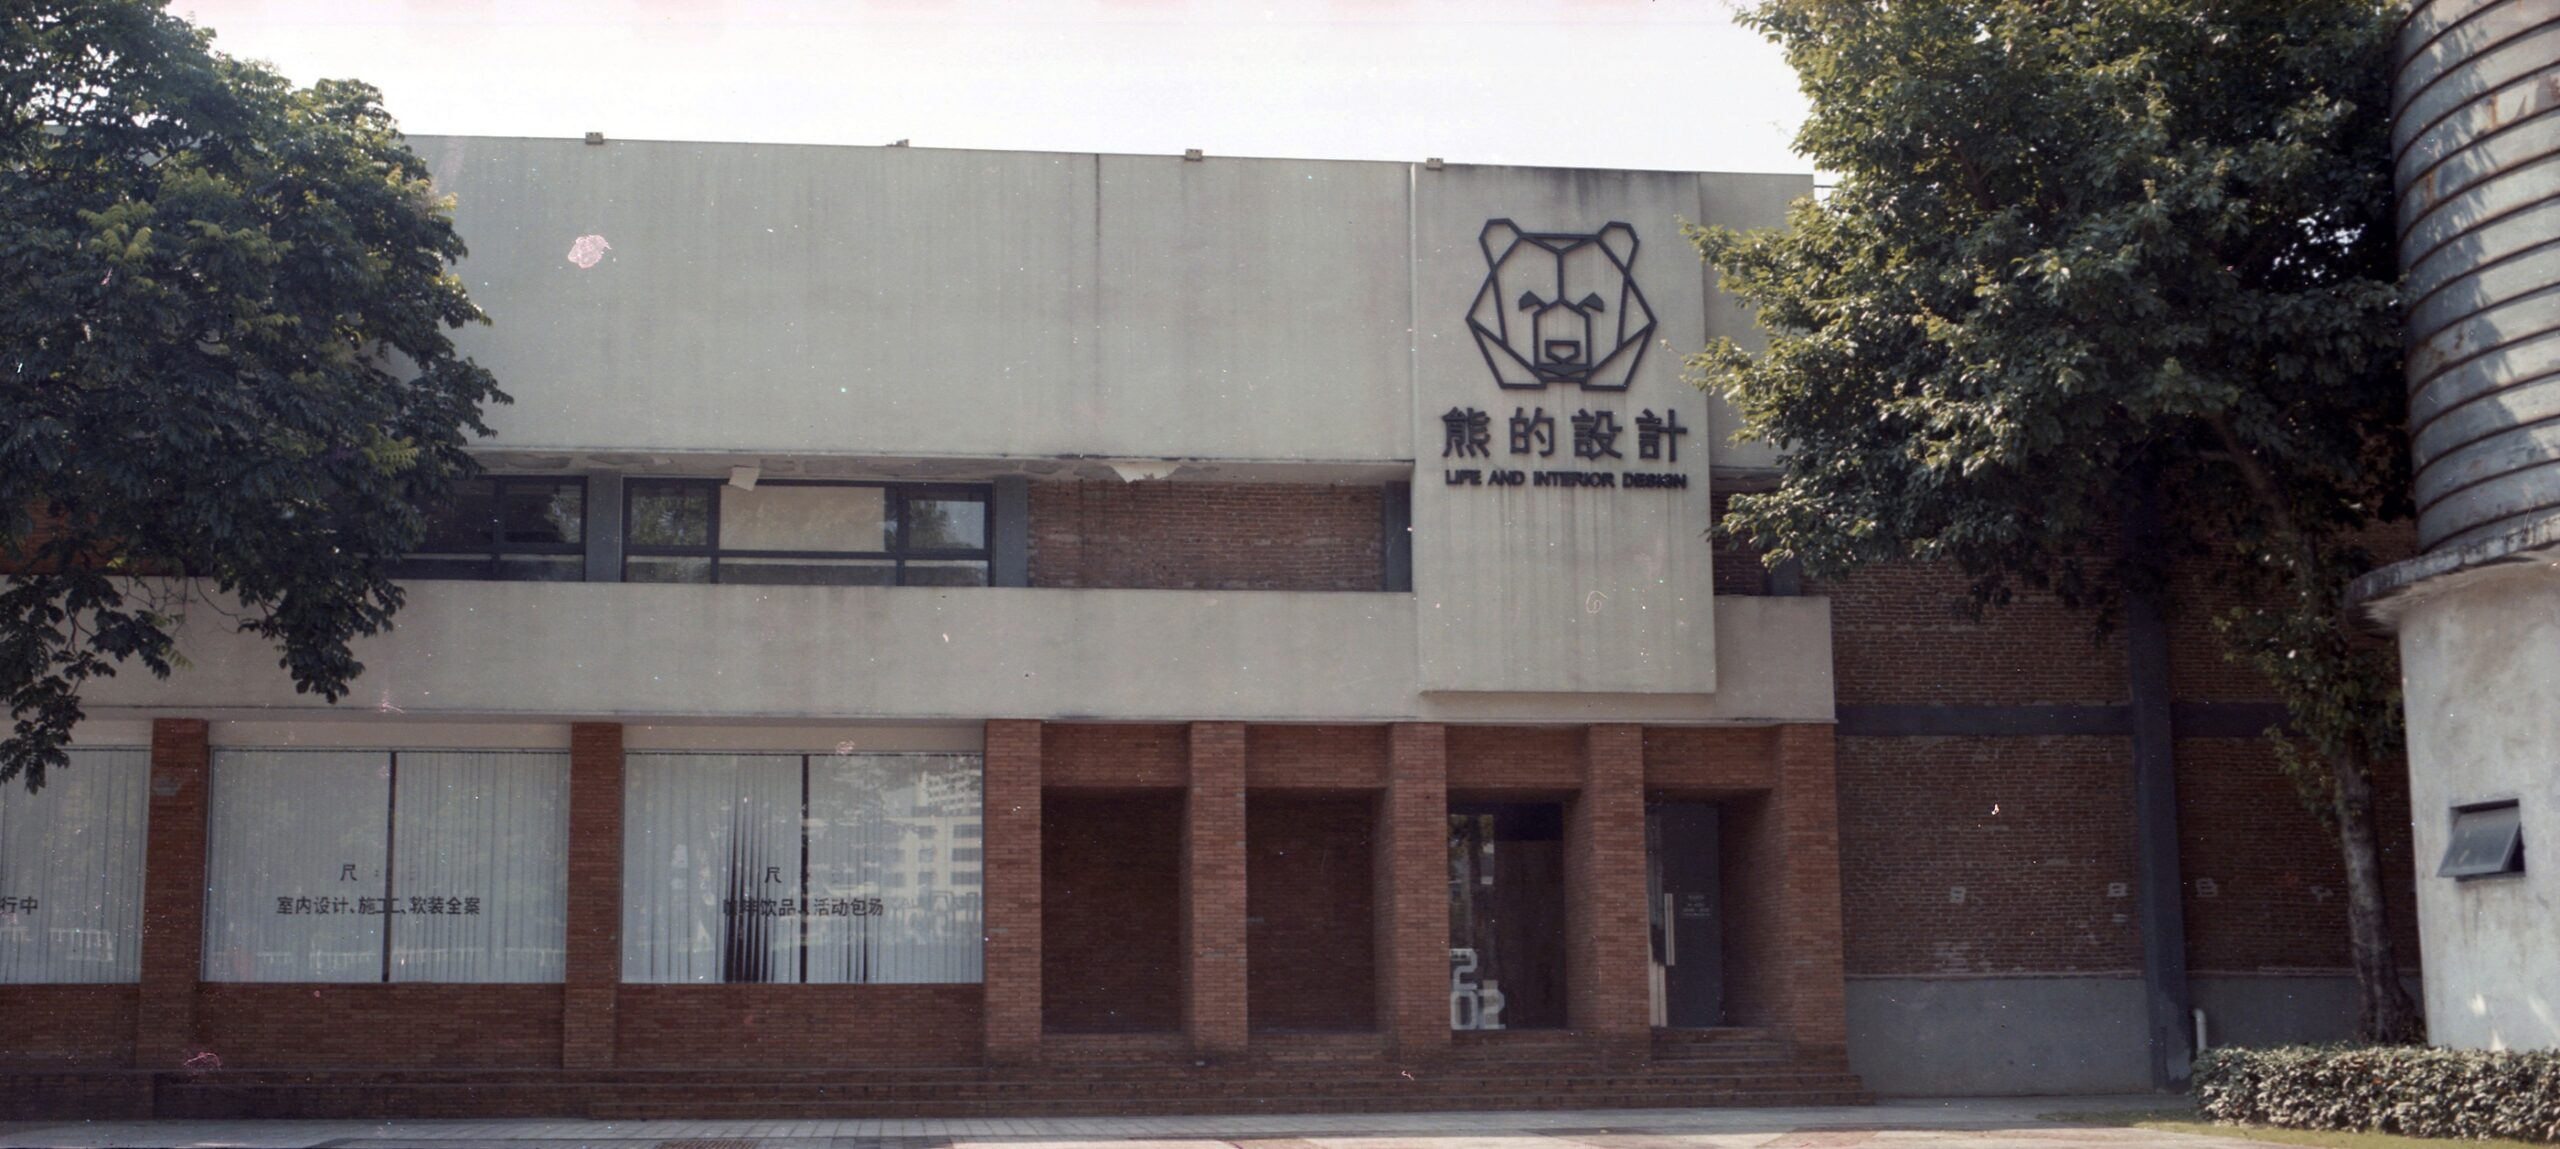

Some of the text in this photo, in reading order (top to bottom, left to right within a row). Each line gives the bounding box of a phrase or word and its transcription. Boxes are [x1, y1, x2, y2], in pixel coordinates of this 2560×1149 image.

[1442, 406, 1688, 463] 熊的設計
[1445, 469, 1688, 490] LIFE AND INTERIOR DESIGN
